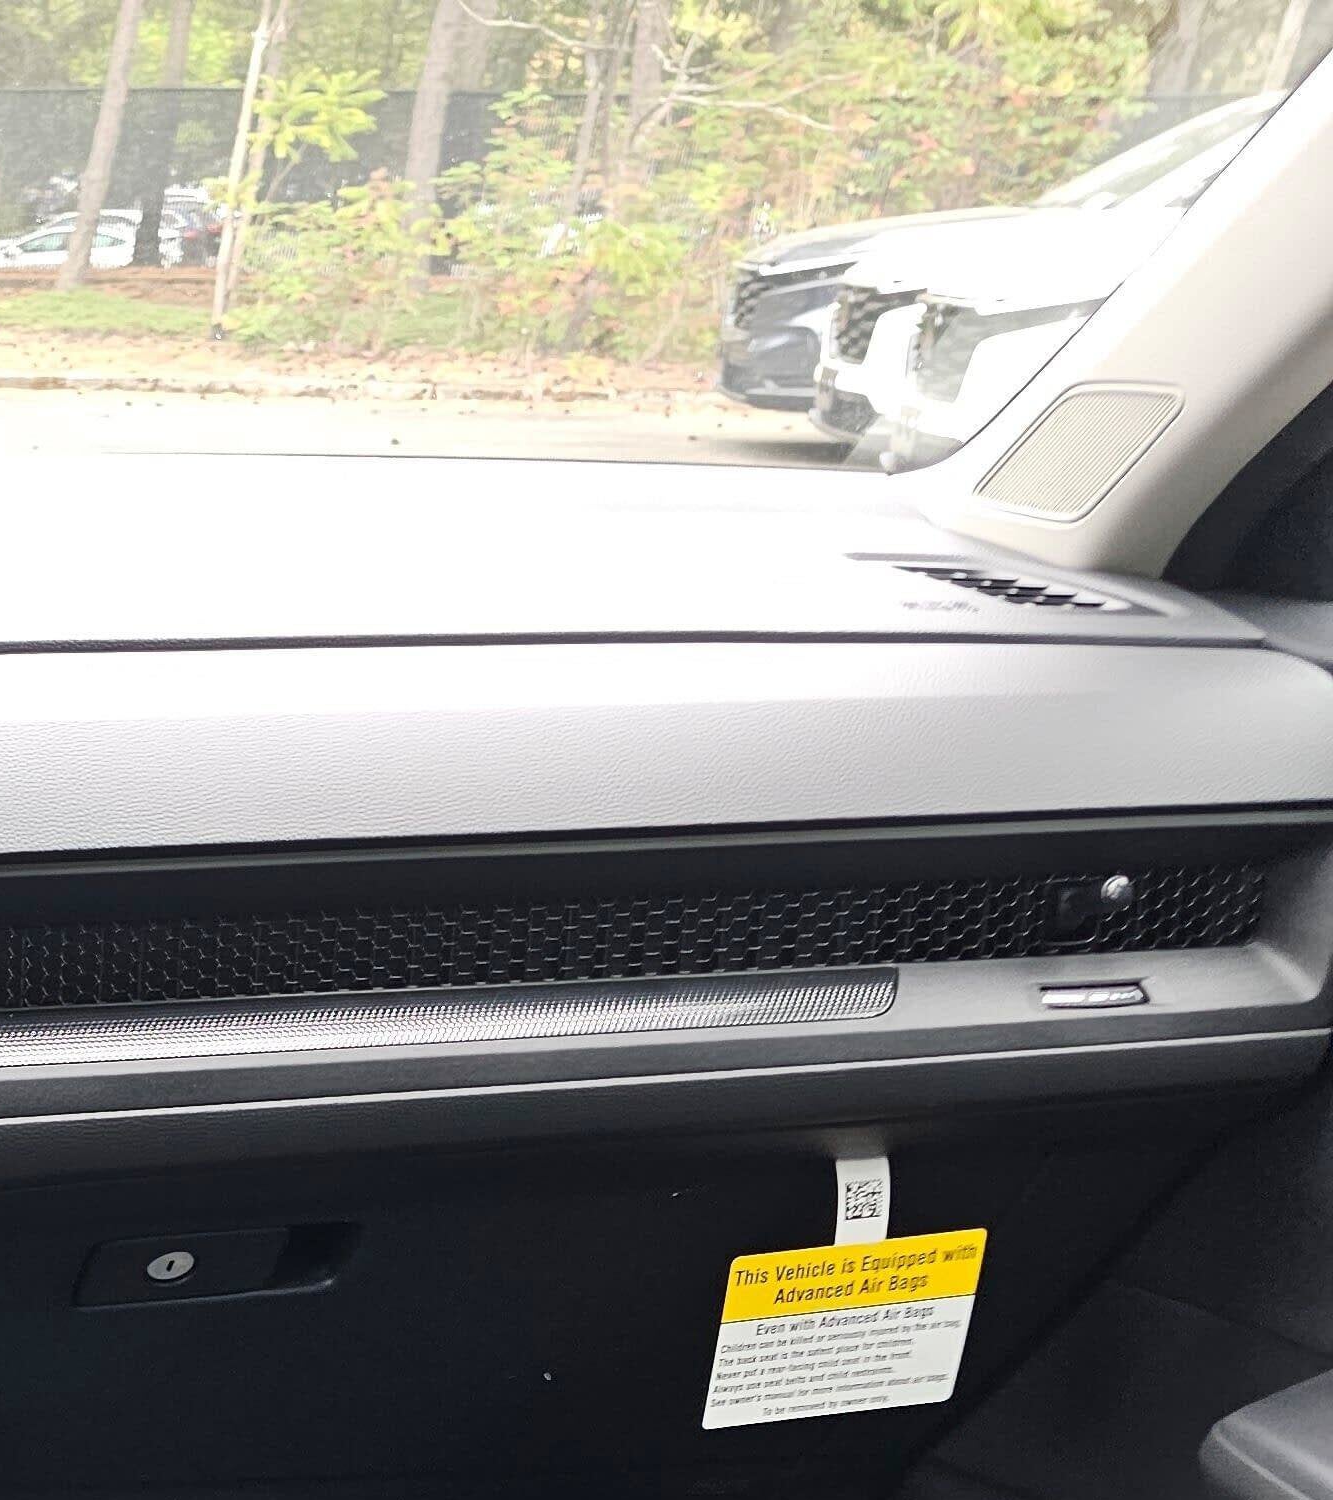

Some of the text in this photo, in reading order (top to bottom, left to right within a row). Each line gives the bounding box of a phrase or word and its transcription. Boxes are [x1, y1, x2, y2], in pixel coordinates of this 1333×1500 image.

[735, 1244, 979, 1286] This Vehicle is Equipped with
[773, 1273, 928, 1304] Advanced Air Bags
[756, 1307, 935, 1335] Even with Advanced Air Bags
